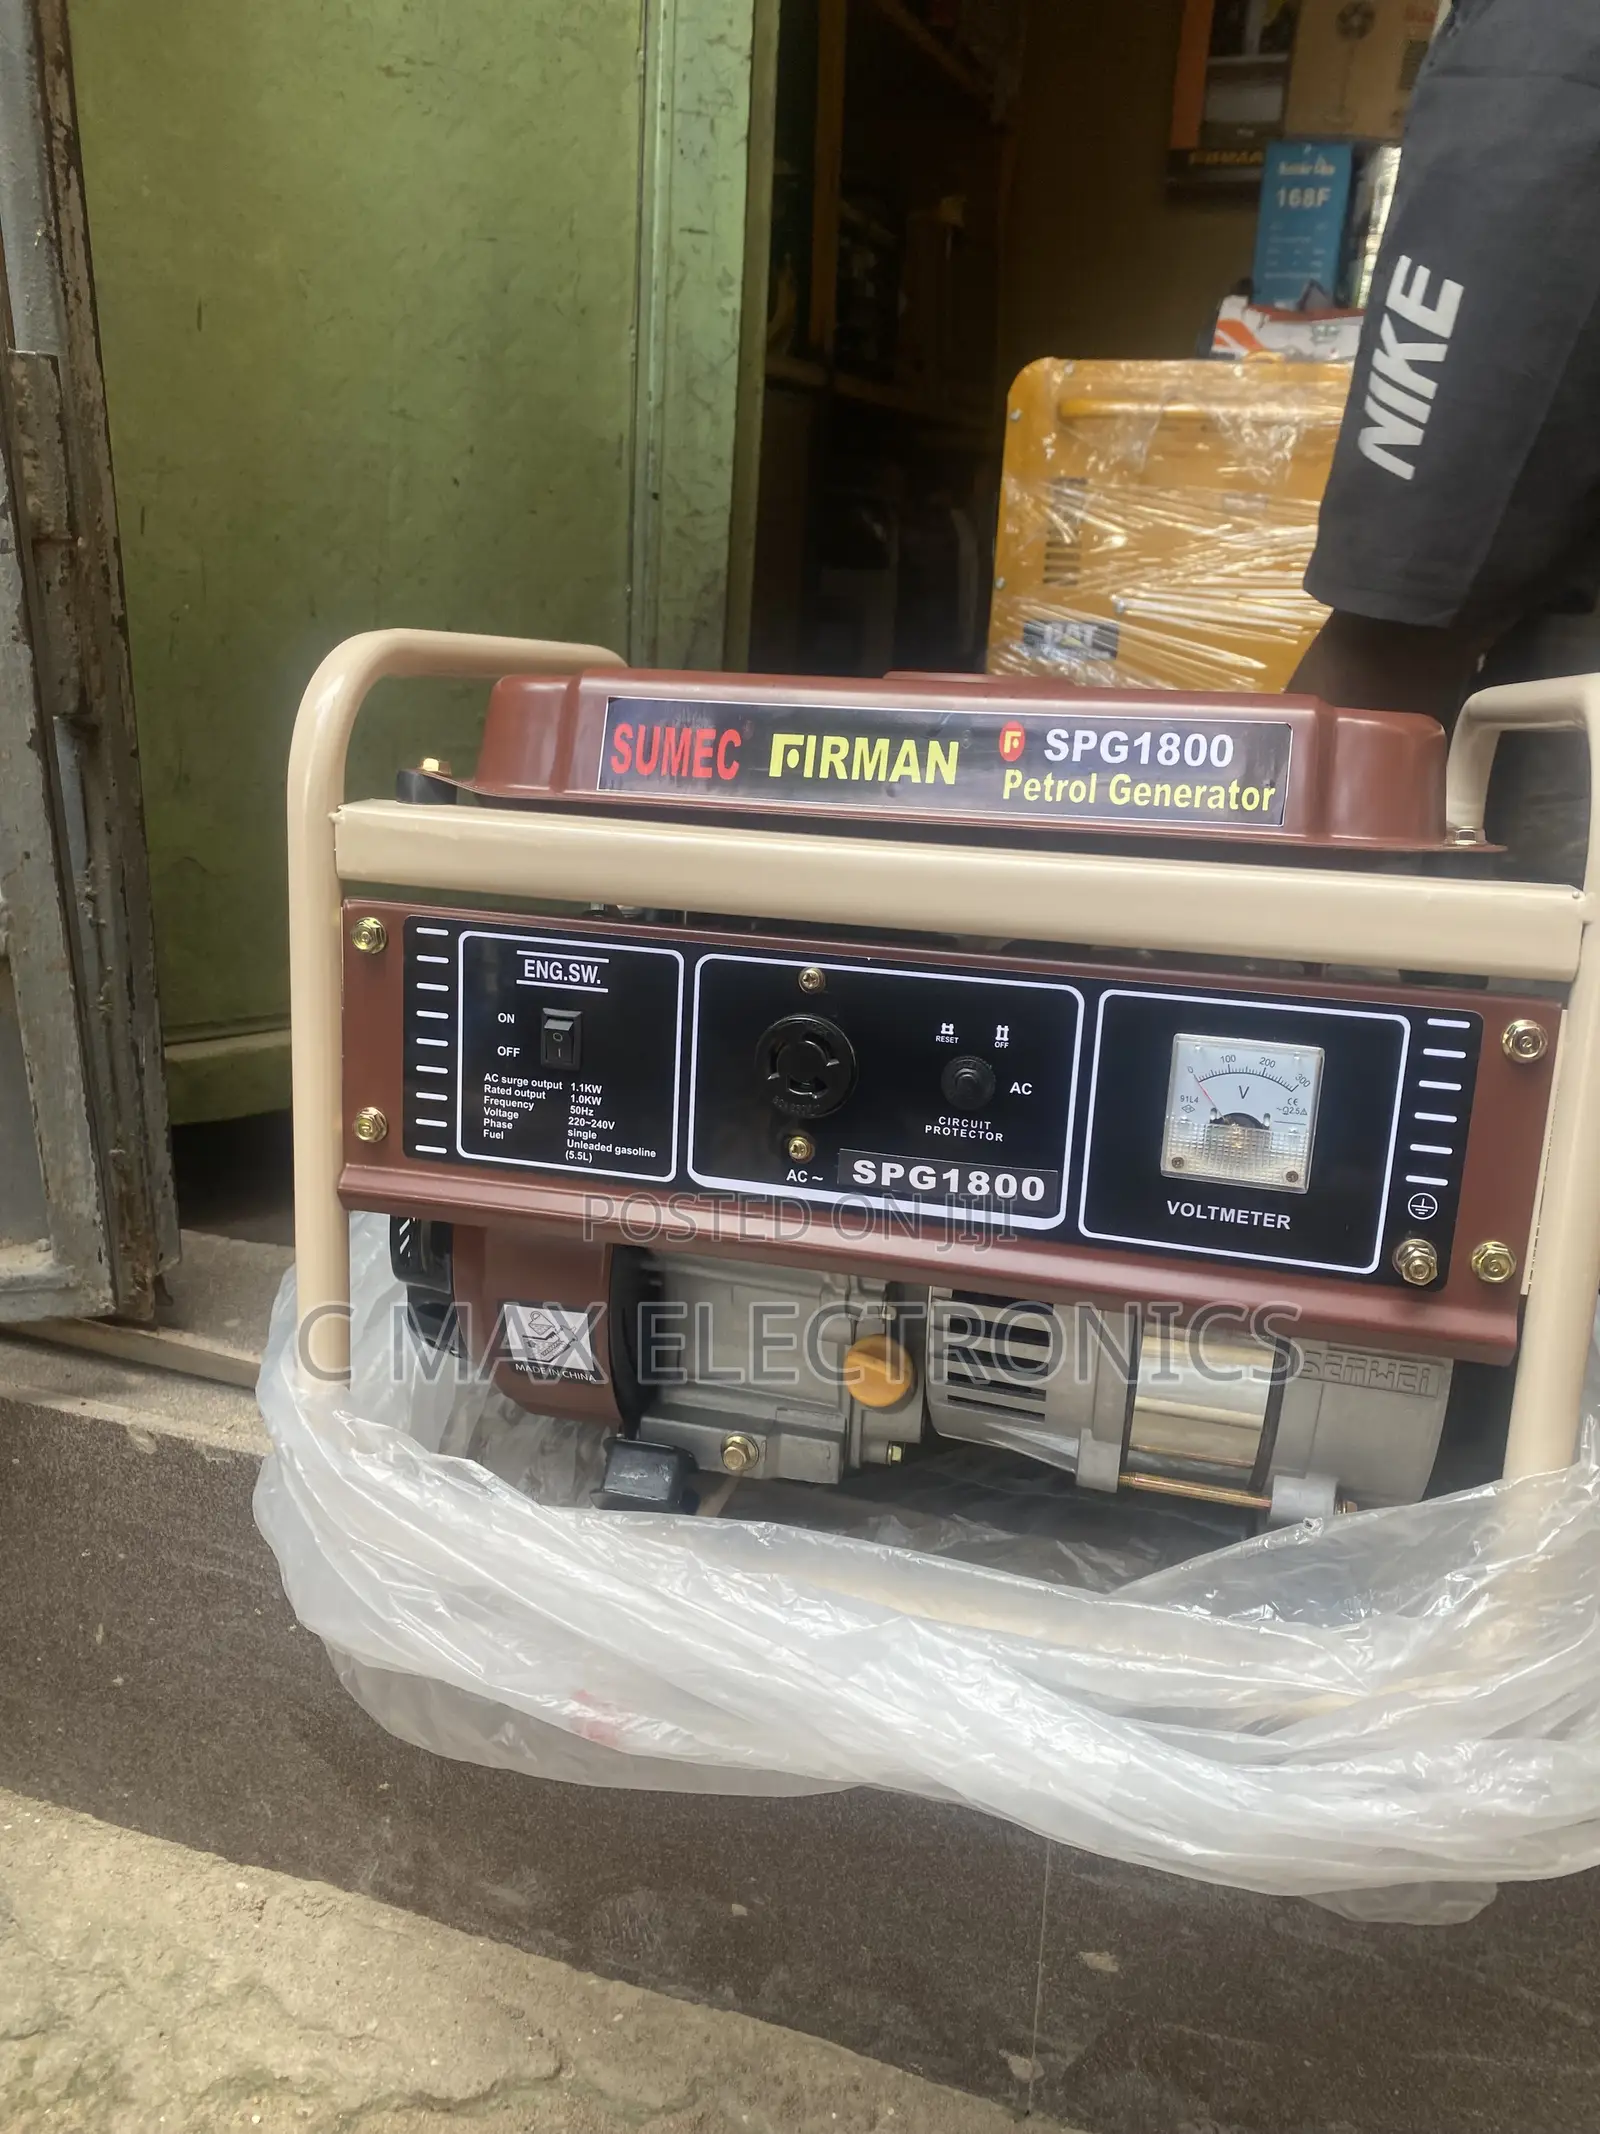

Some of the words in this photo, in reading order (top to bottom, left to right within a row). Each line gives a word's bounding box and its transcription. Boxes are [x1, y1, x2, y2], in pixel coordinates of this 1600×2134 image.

[1358, 255, 1464, 480] NIKE
[611, 722, 742, 780] SUMEC
[769, 734, 959, 785] FIRMAN
[1044, 728, 1234, 768] SPG1800
[1002, 769, 1097, 804] Petrol
[1108, 773, 1275, 811] Generator
[524, 959, 601, 984] ENG.SW.
[498, 1013, 515, 1024] ON
[935, 1035, 959, 1044] RESET
[497, 1046, 520, 1057] OFF
[1220, 1054, 1237, 1063] 100
[1187, 1066, 1194, 1074] 0
[1259, 1057, 1276, 1068] 200
[484, 1073, 499, 1083] AC
[501, 1077, 529, 1087] surge
[531, 1080, 563, 1090] output
[570, 1082, 602, 1094] 1.1KW
[1009, 1082, 1033, 1095] AC
[1294, 1073, 1311, 1088] 300
[484, 1084, 512, 1096] Rated
[514, 1089, 546, 1100] output
[570, 1094, 602, 1106] 1.0KW
[1180, 1095, 1199, 1103] 91L4
[1238, 1085, 1250, 1099] V
[484, 1096, 535, 1111] Frequency
[569, 1106, 595, 1117] 50Hz
[483, 1107, 520, 1120] Voltage
[568, 1117, 615, 1130] 220~240V
[938, 1116, 991, 1130] CIRCUIT
[483, 1118, 513, 1129] Phase
[567, 1128, 598, 1140] single
[925, 1125, 1003, 1142] PROTECTOR
[483, 1129, 504, 1140] Fuel
[566, 1138, 613, 1152] Unleaded
[614, 1146, 657, 1158] gasoline
[565, 1151, 593, 1163] (5.5L)
[786, 1170, 808, 1183] AC
[852, 1159, 1045, 1201] SPG1800
[1166, 1200, 1291, 1230] VOLTMETER
[515, 1363, 547, 1374] MADE
[548, 1368, 559, 1376] IN
[562, 1370, 597, 1382] CHINA
